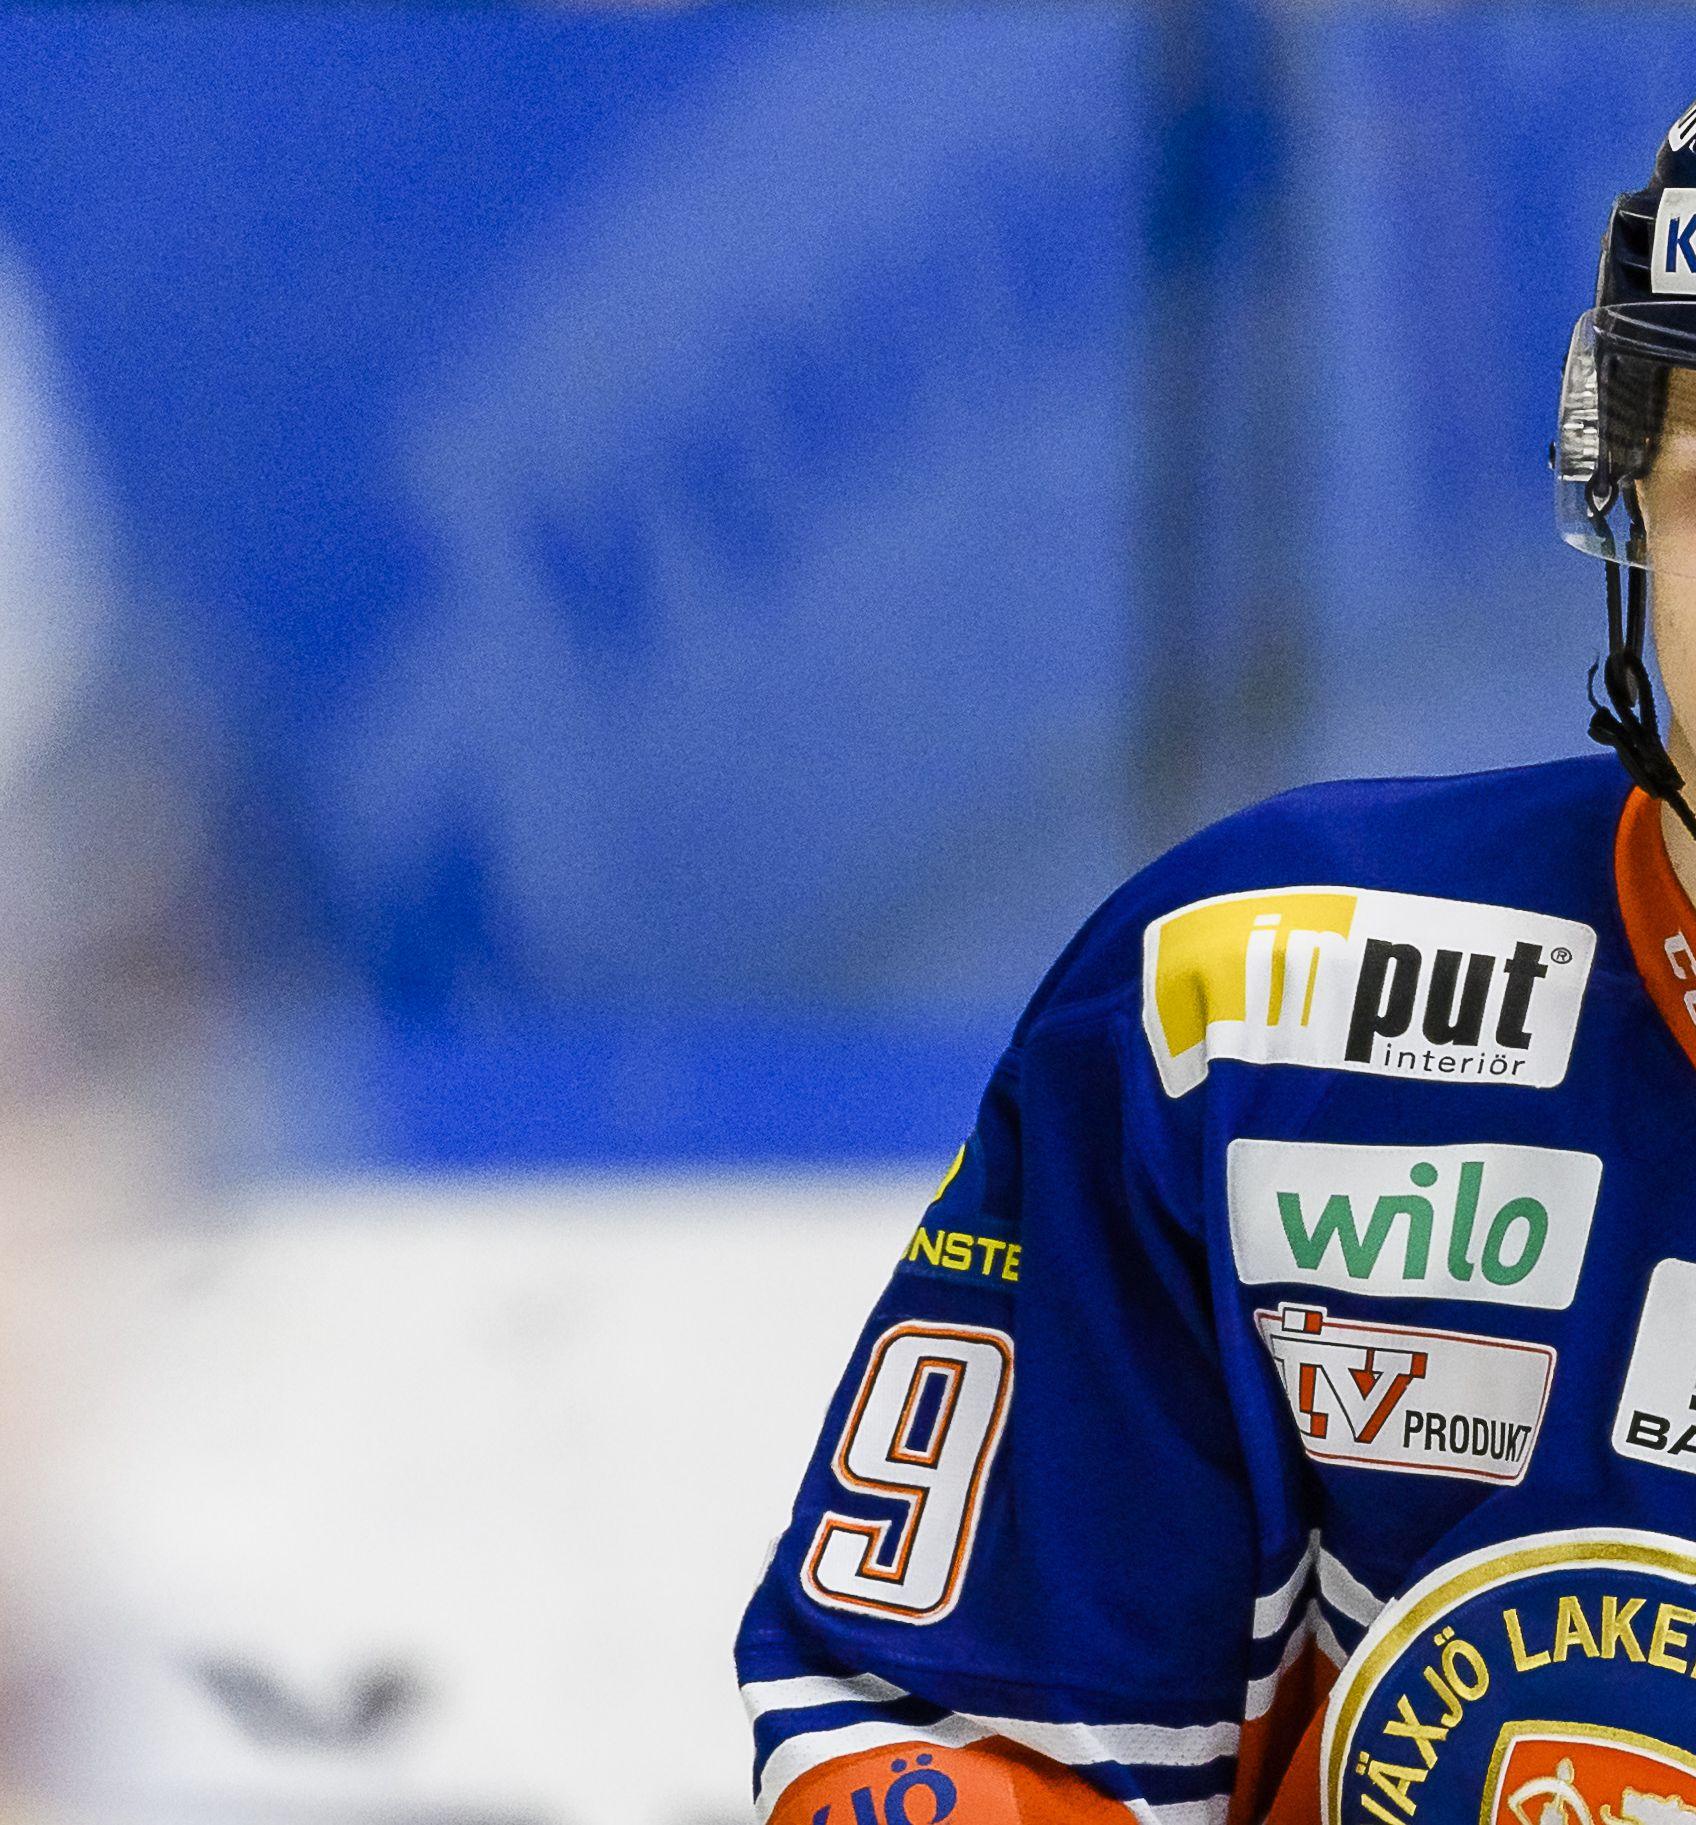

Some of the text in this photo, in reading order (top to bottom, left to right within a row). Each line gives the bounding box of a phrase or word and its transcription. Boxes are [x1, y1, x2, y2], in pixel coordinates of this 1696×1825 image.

[1384, 1042, 1526, 1077] interiör
[1276, 1161, 1549, 1286] wilo
[900, 1226, 1022, 1281] NSTE
[1402, 1409, 1533, 1464] PRODUKT
[801, 1319, 1014, 1625] 9
